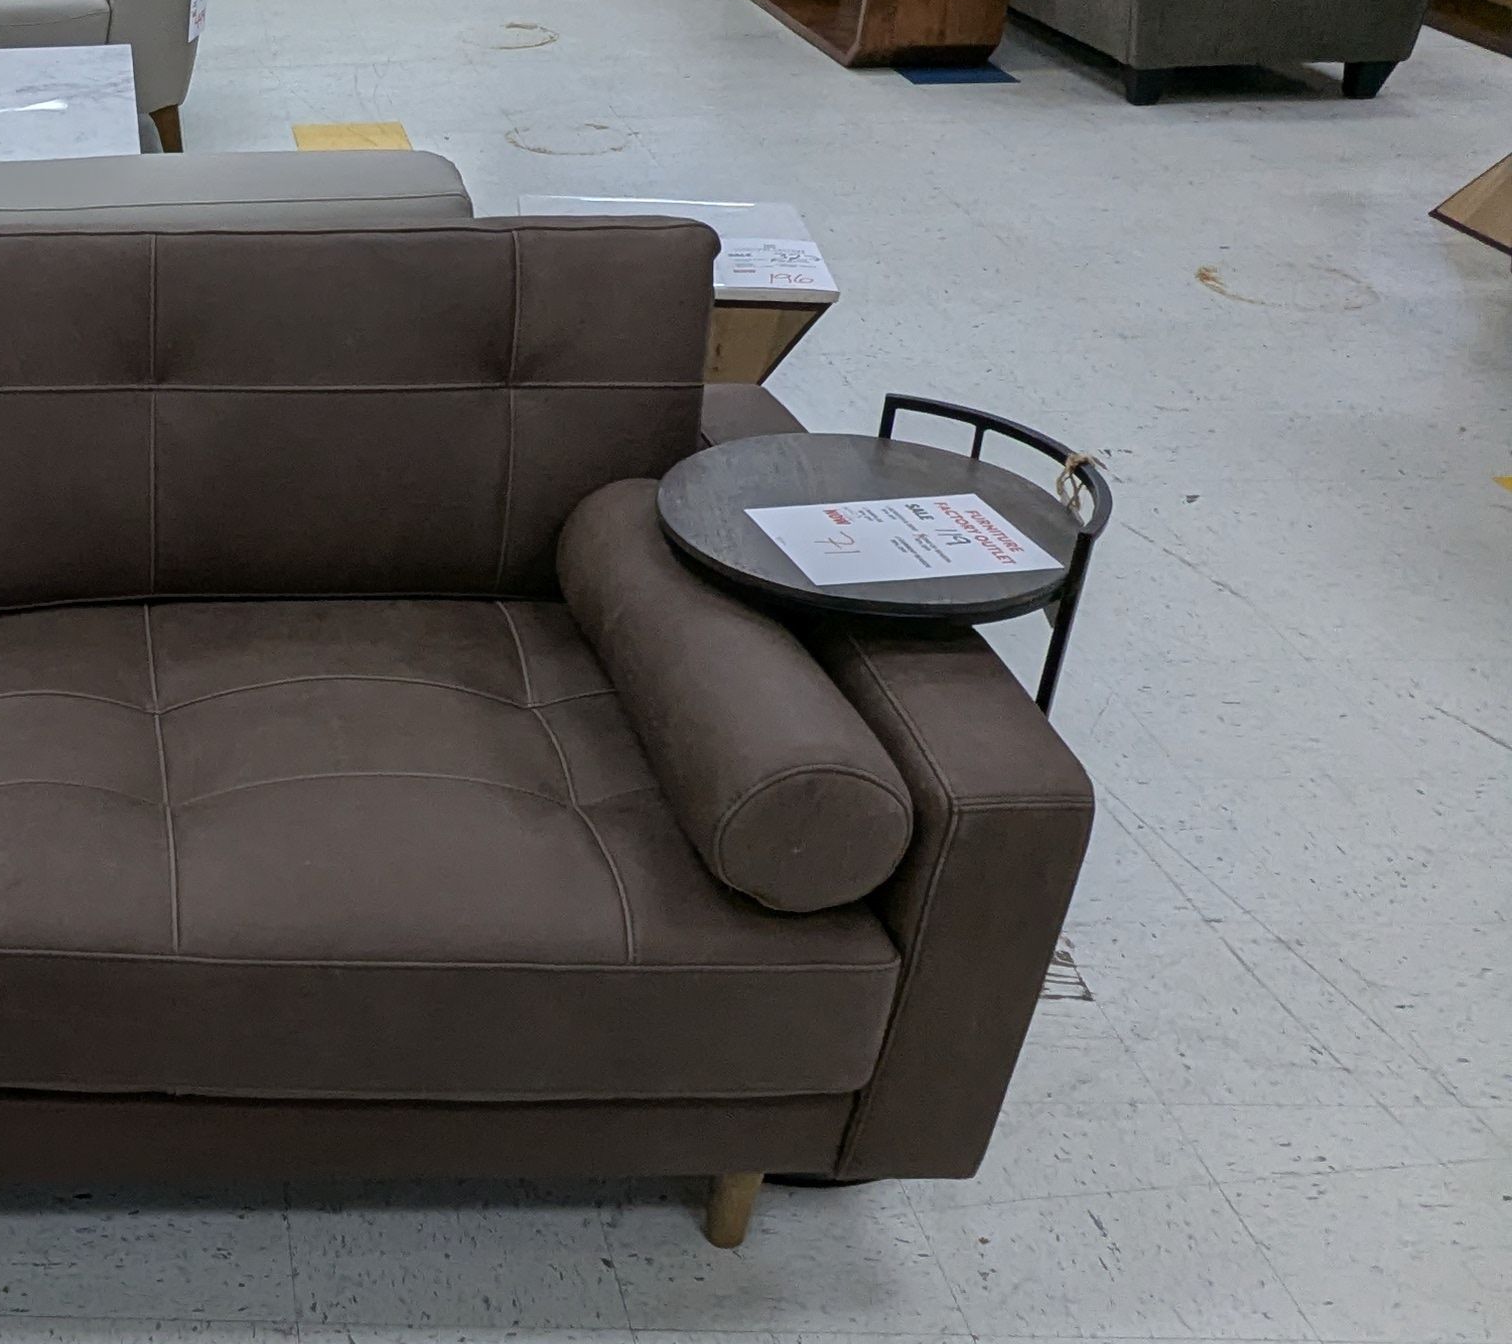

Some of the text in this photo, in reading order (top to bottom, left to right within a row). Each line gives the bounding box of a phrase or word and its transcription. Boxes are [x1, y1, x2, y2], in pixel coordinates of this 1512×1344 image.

[823, 509, 852, 525] NOW
[905, 503, 935, 521] SALE
[934, 502, 983, 534] FACTORY
[974, 535, 1017, 565] OUTLET
[964, 510, 1025, 554] FURNITURE
